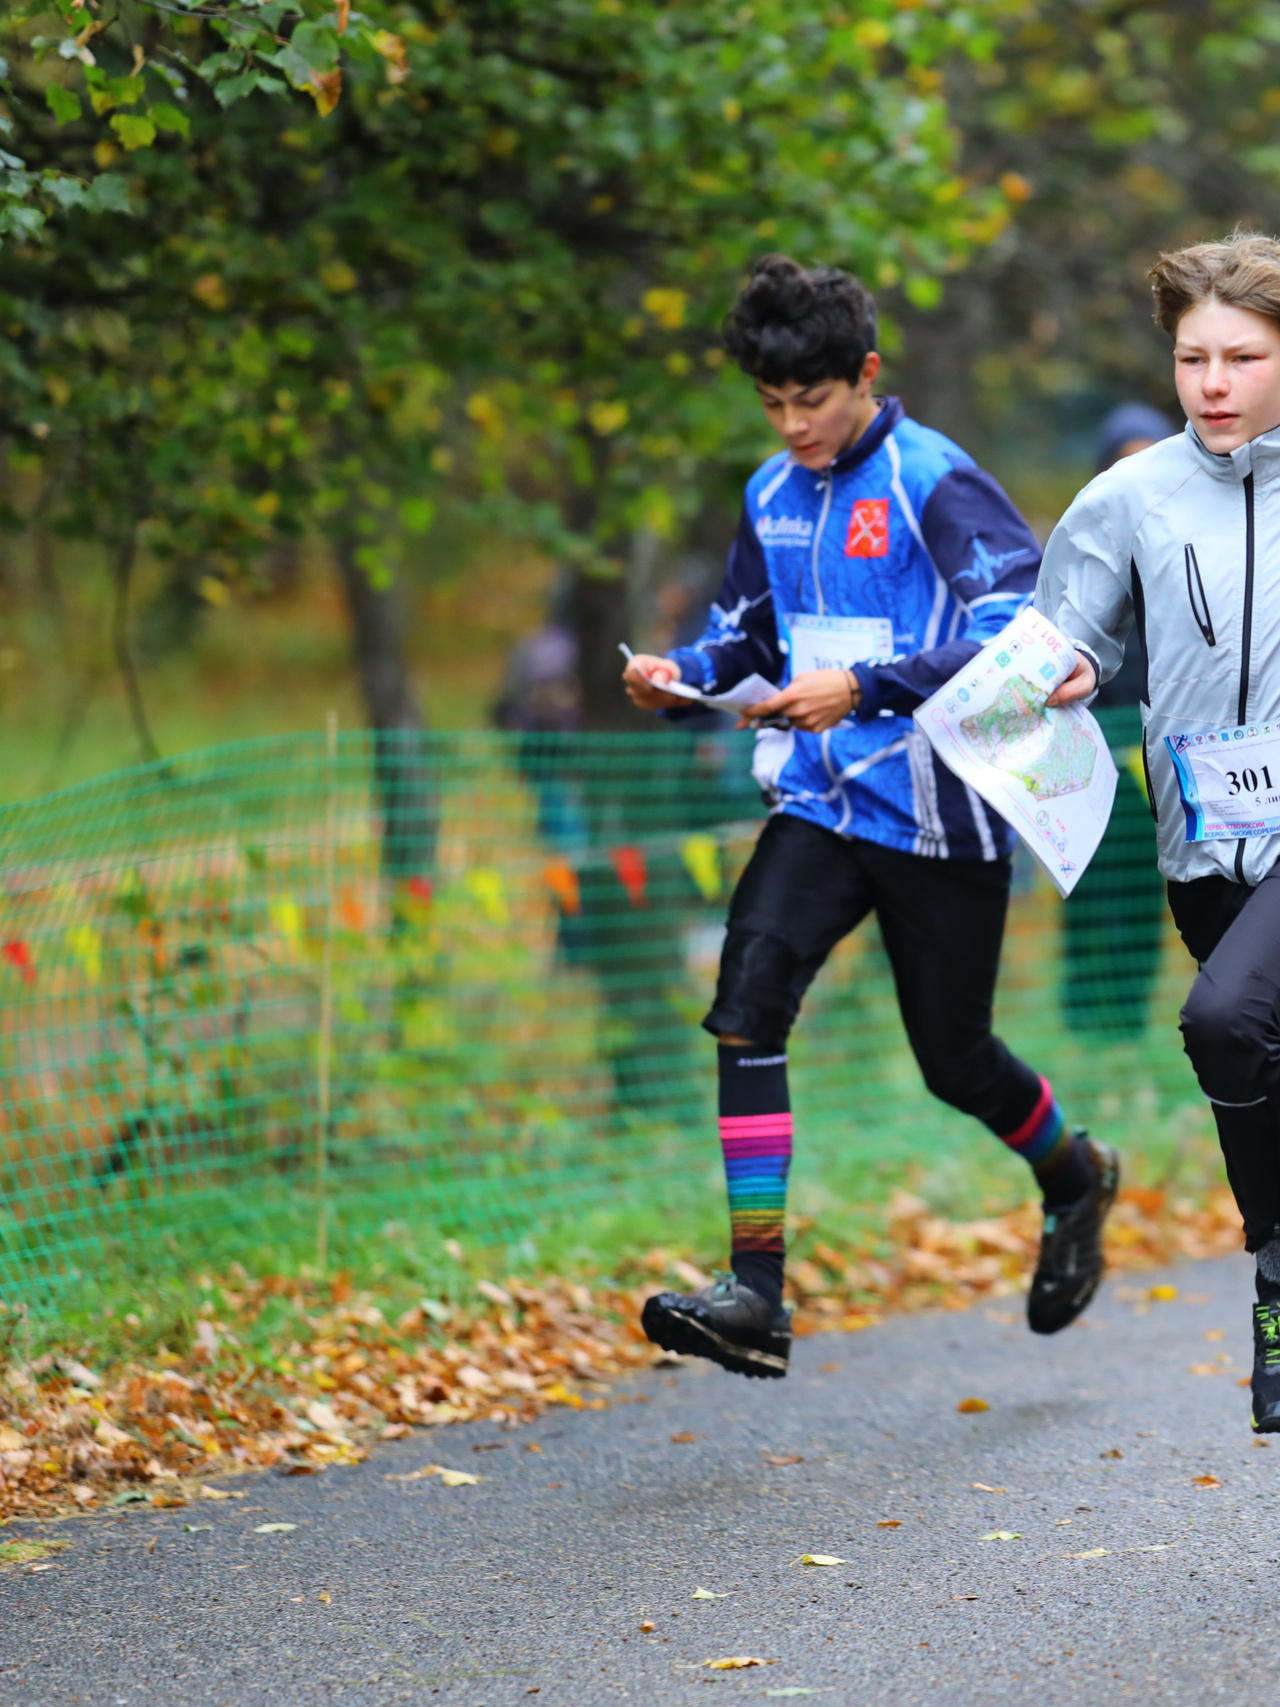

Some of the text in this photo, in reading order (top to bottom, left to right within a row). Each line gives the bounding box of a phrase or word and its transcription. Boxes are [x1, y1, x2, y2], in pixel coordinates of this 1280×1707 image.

[1041, 630, 1063, 654] 301
[1225, 765, 1275, 796] 301
[1255, 797, 1262, 807] 5
[1204, 821, 1266, 832] ПЕРВЕНСТВО РОССИИ
